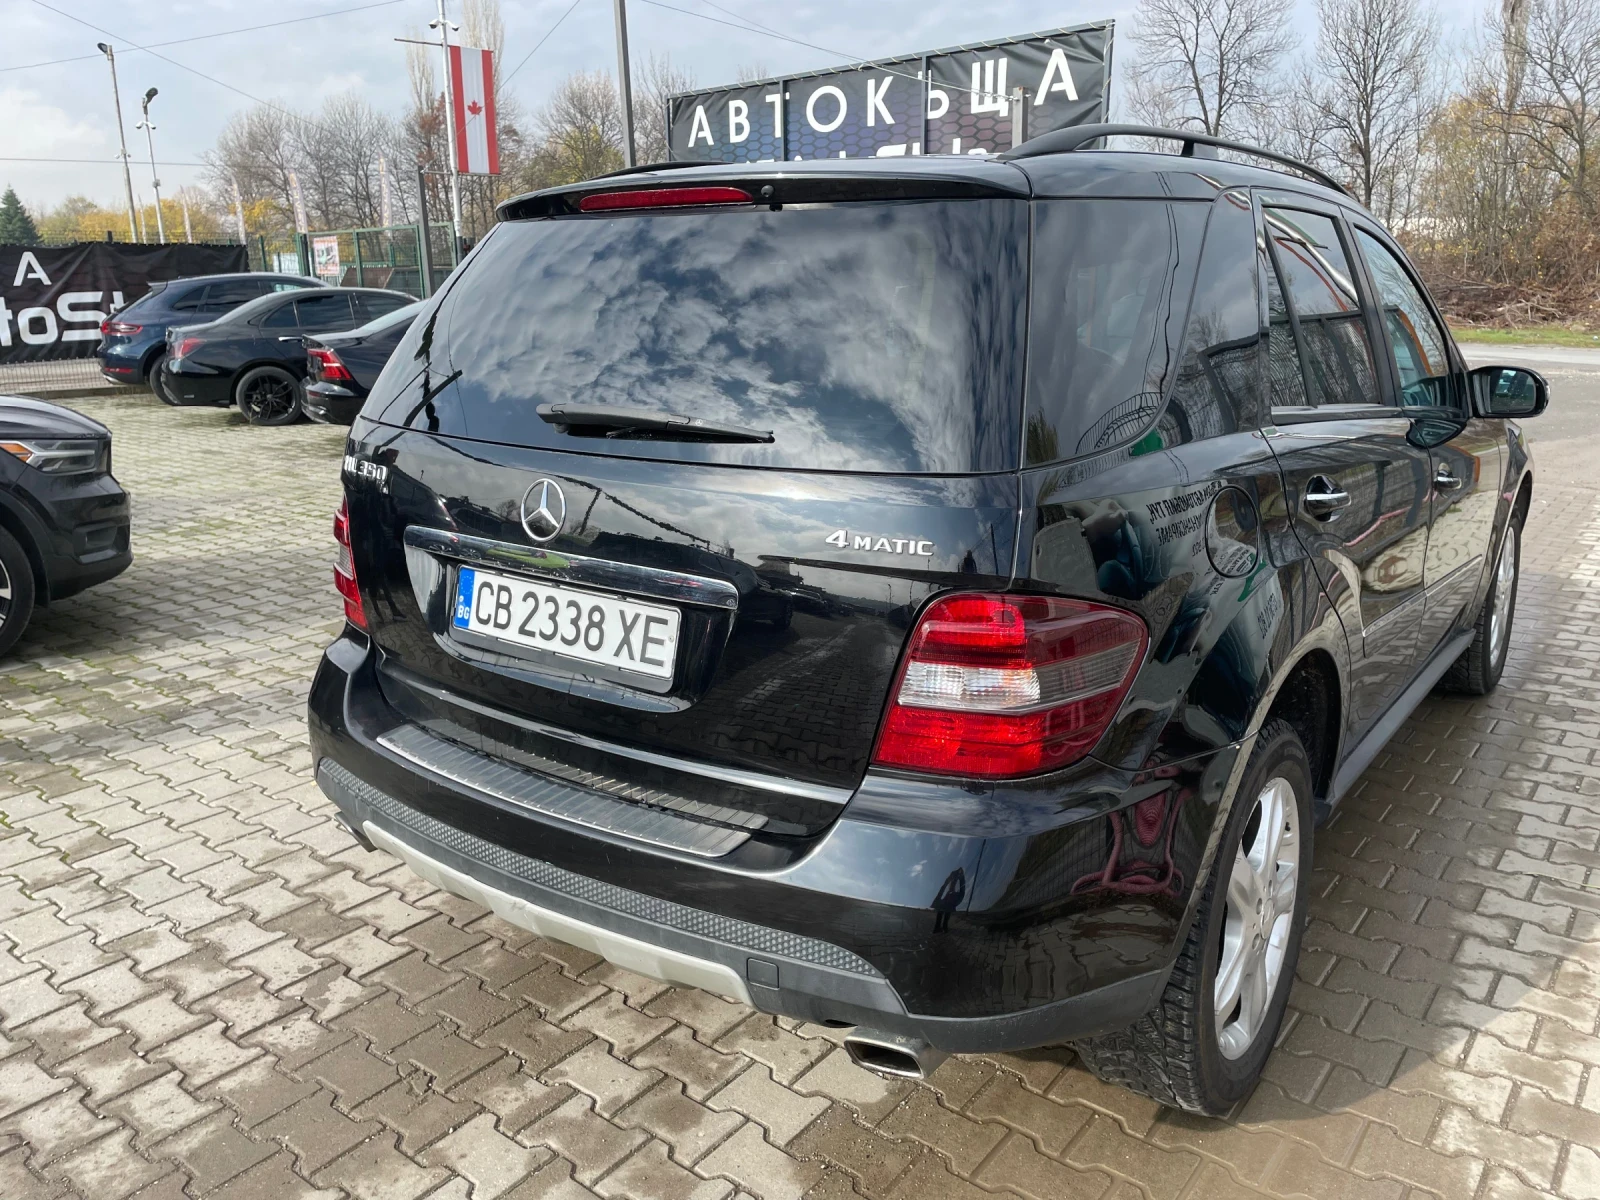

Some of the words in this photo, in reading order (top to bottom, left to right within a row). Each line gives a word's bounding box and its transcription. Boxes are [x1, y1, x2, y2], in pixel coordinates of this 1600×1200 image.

[457, 604, 470, 620] BG
[475, 581, 512, 630] CB
[518, 591, 605, 651] 2338
[613, 609, 669, 667] XE
